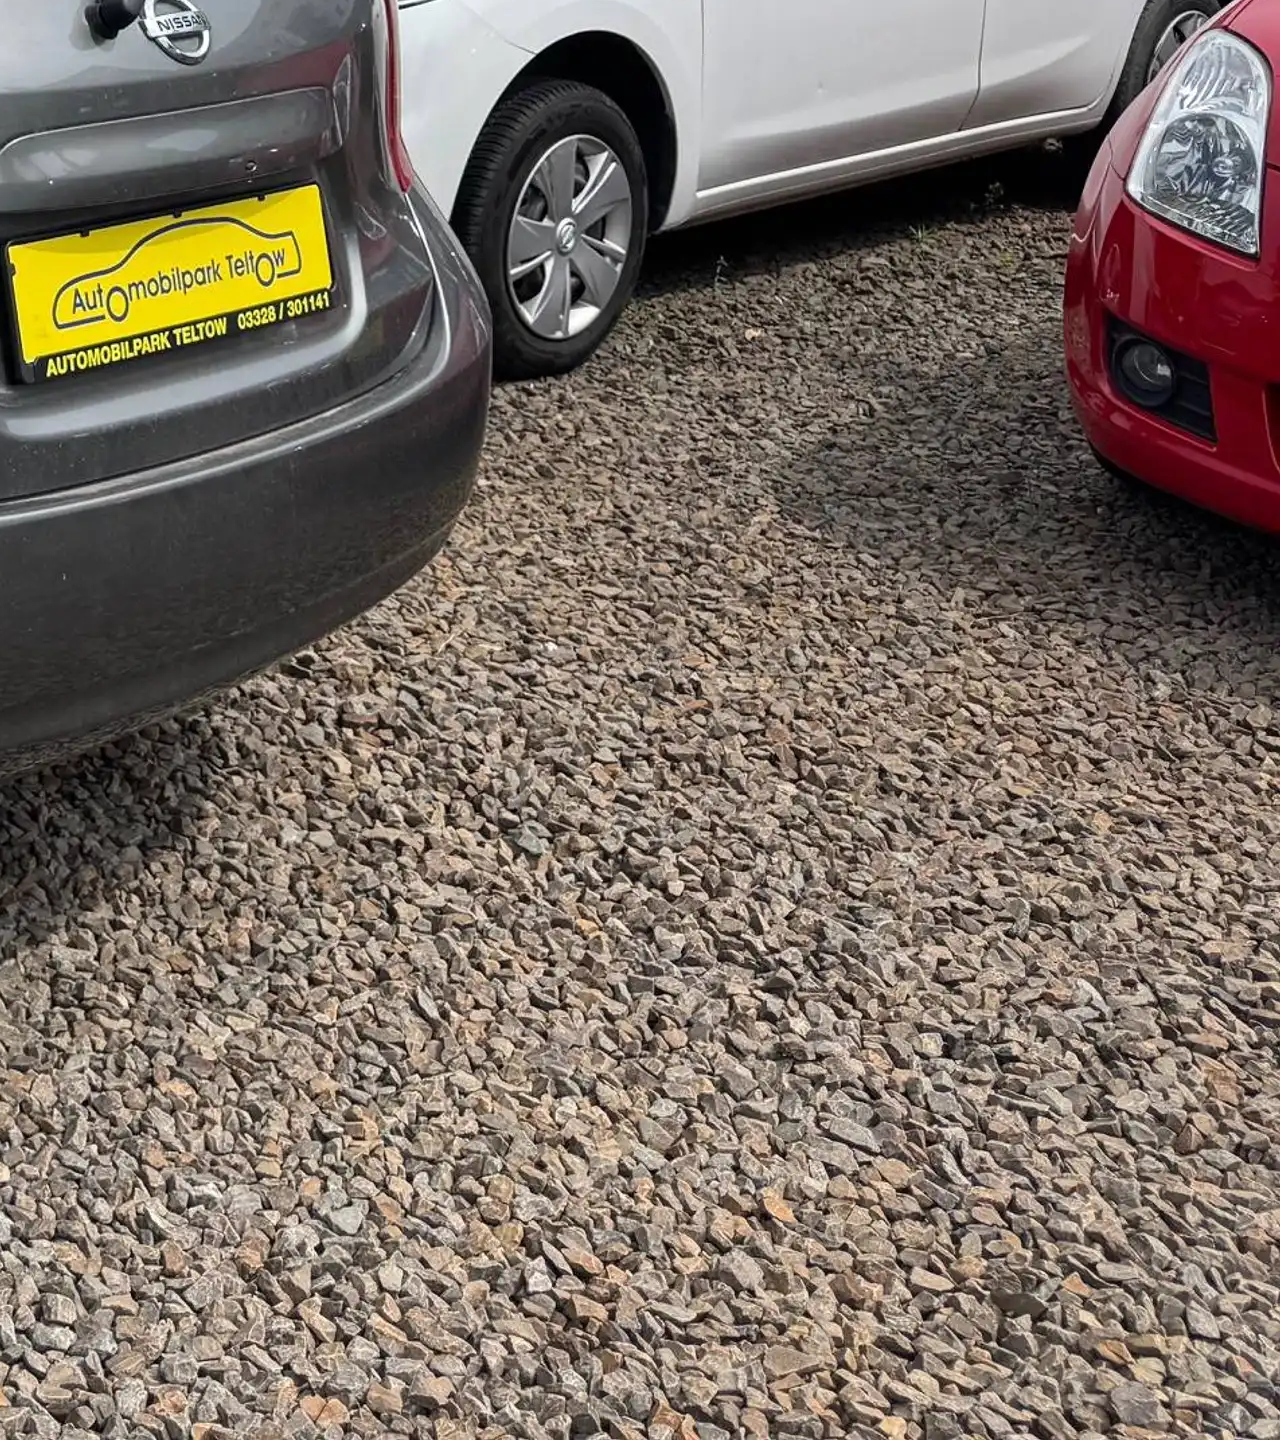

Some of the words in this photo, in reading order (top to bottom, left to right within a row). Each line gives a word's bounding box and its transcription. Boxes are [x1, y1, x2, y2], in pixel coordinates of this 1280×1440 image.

[156, 13, 203, 32] NISSAN
[45, 332, 172, 377] AUTOMOBILPARK
[172, 317, 228, 346] TELTOW
[237, 303, 277, 330] 03328
[276, 300, 285, 322] /
[287, 292, 330, 319] 301141
